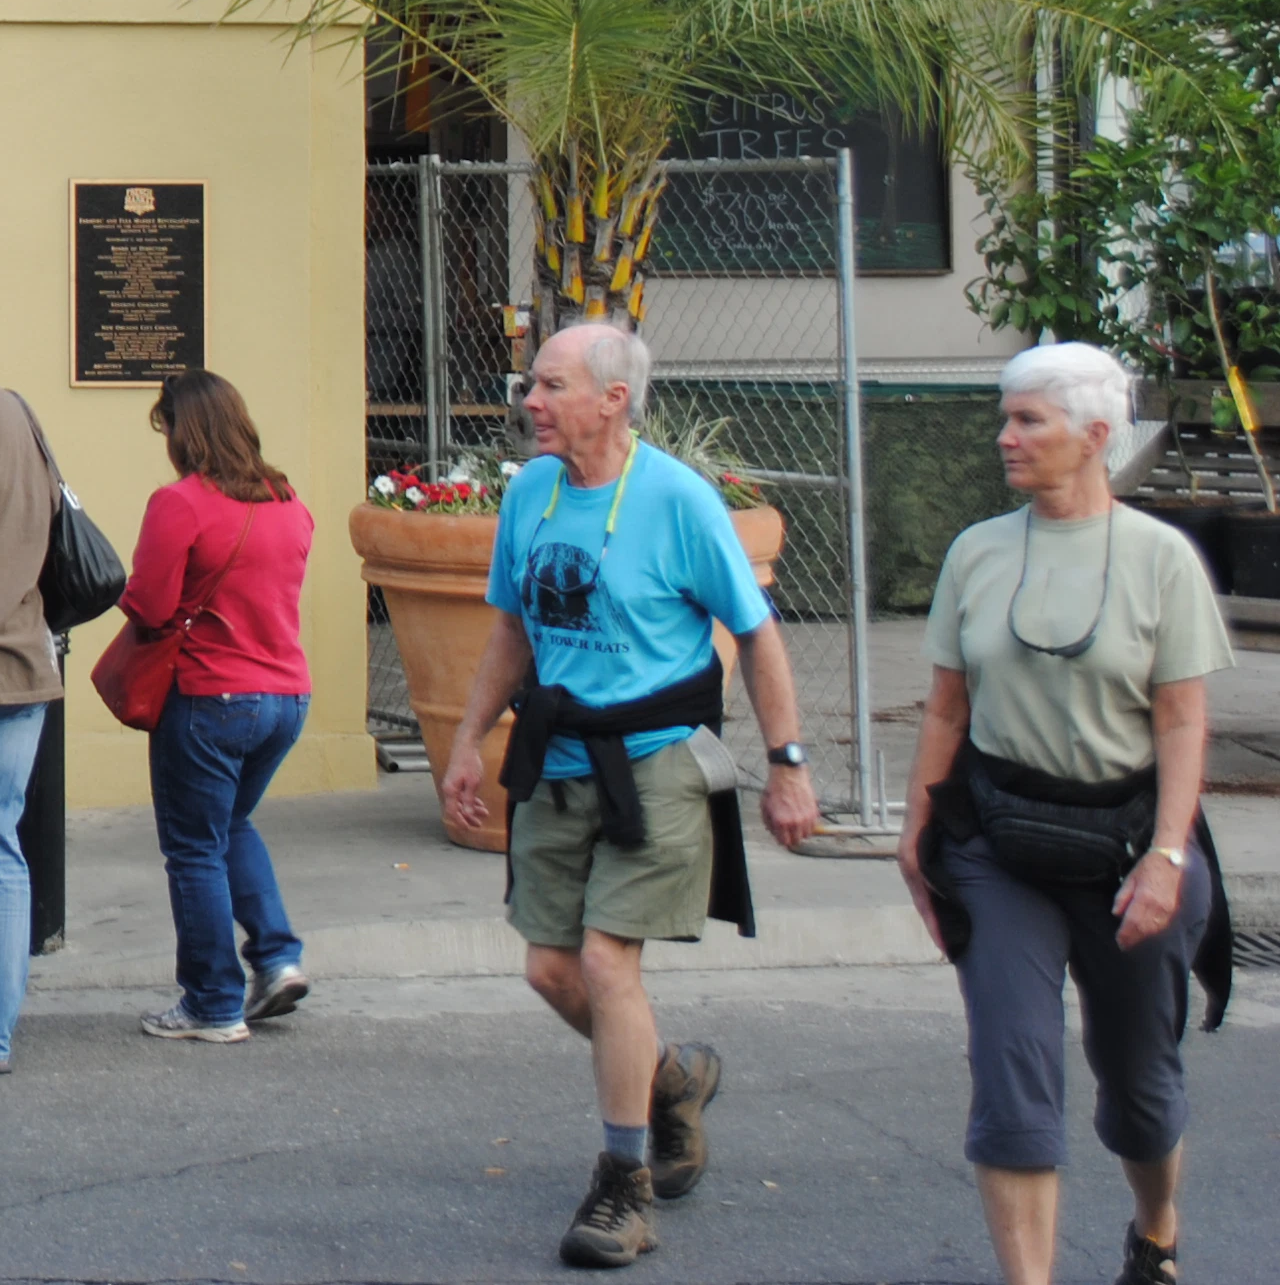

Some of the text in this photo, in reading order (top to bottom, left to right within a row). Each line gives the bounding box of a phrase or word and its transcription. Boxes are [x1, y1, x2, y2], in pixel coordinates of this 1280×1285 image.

[704, 92, 826, 126] CITRUS
[550, 634, 589, 650] TOWER
[594, 639, 631, 654] RATS
